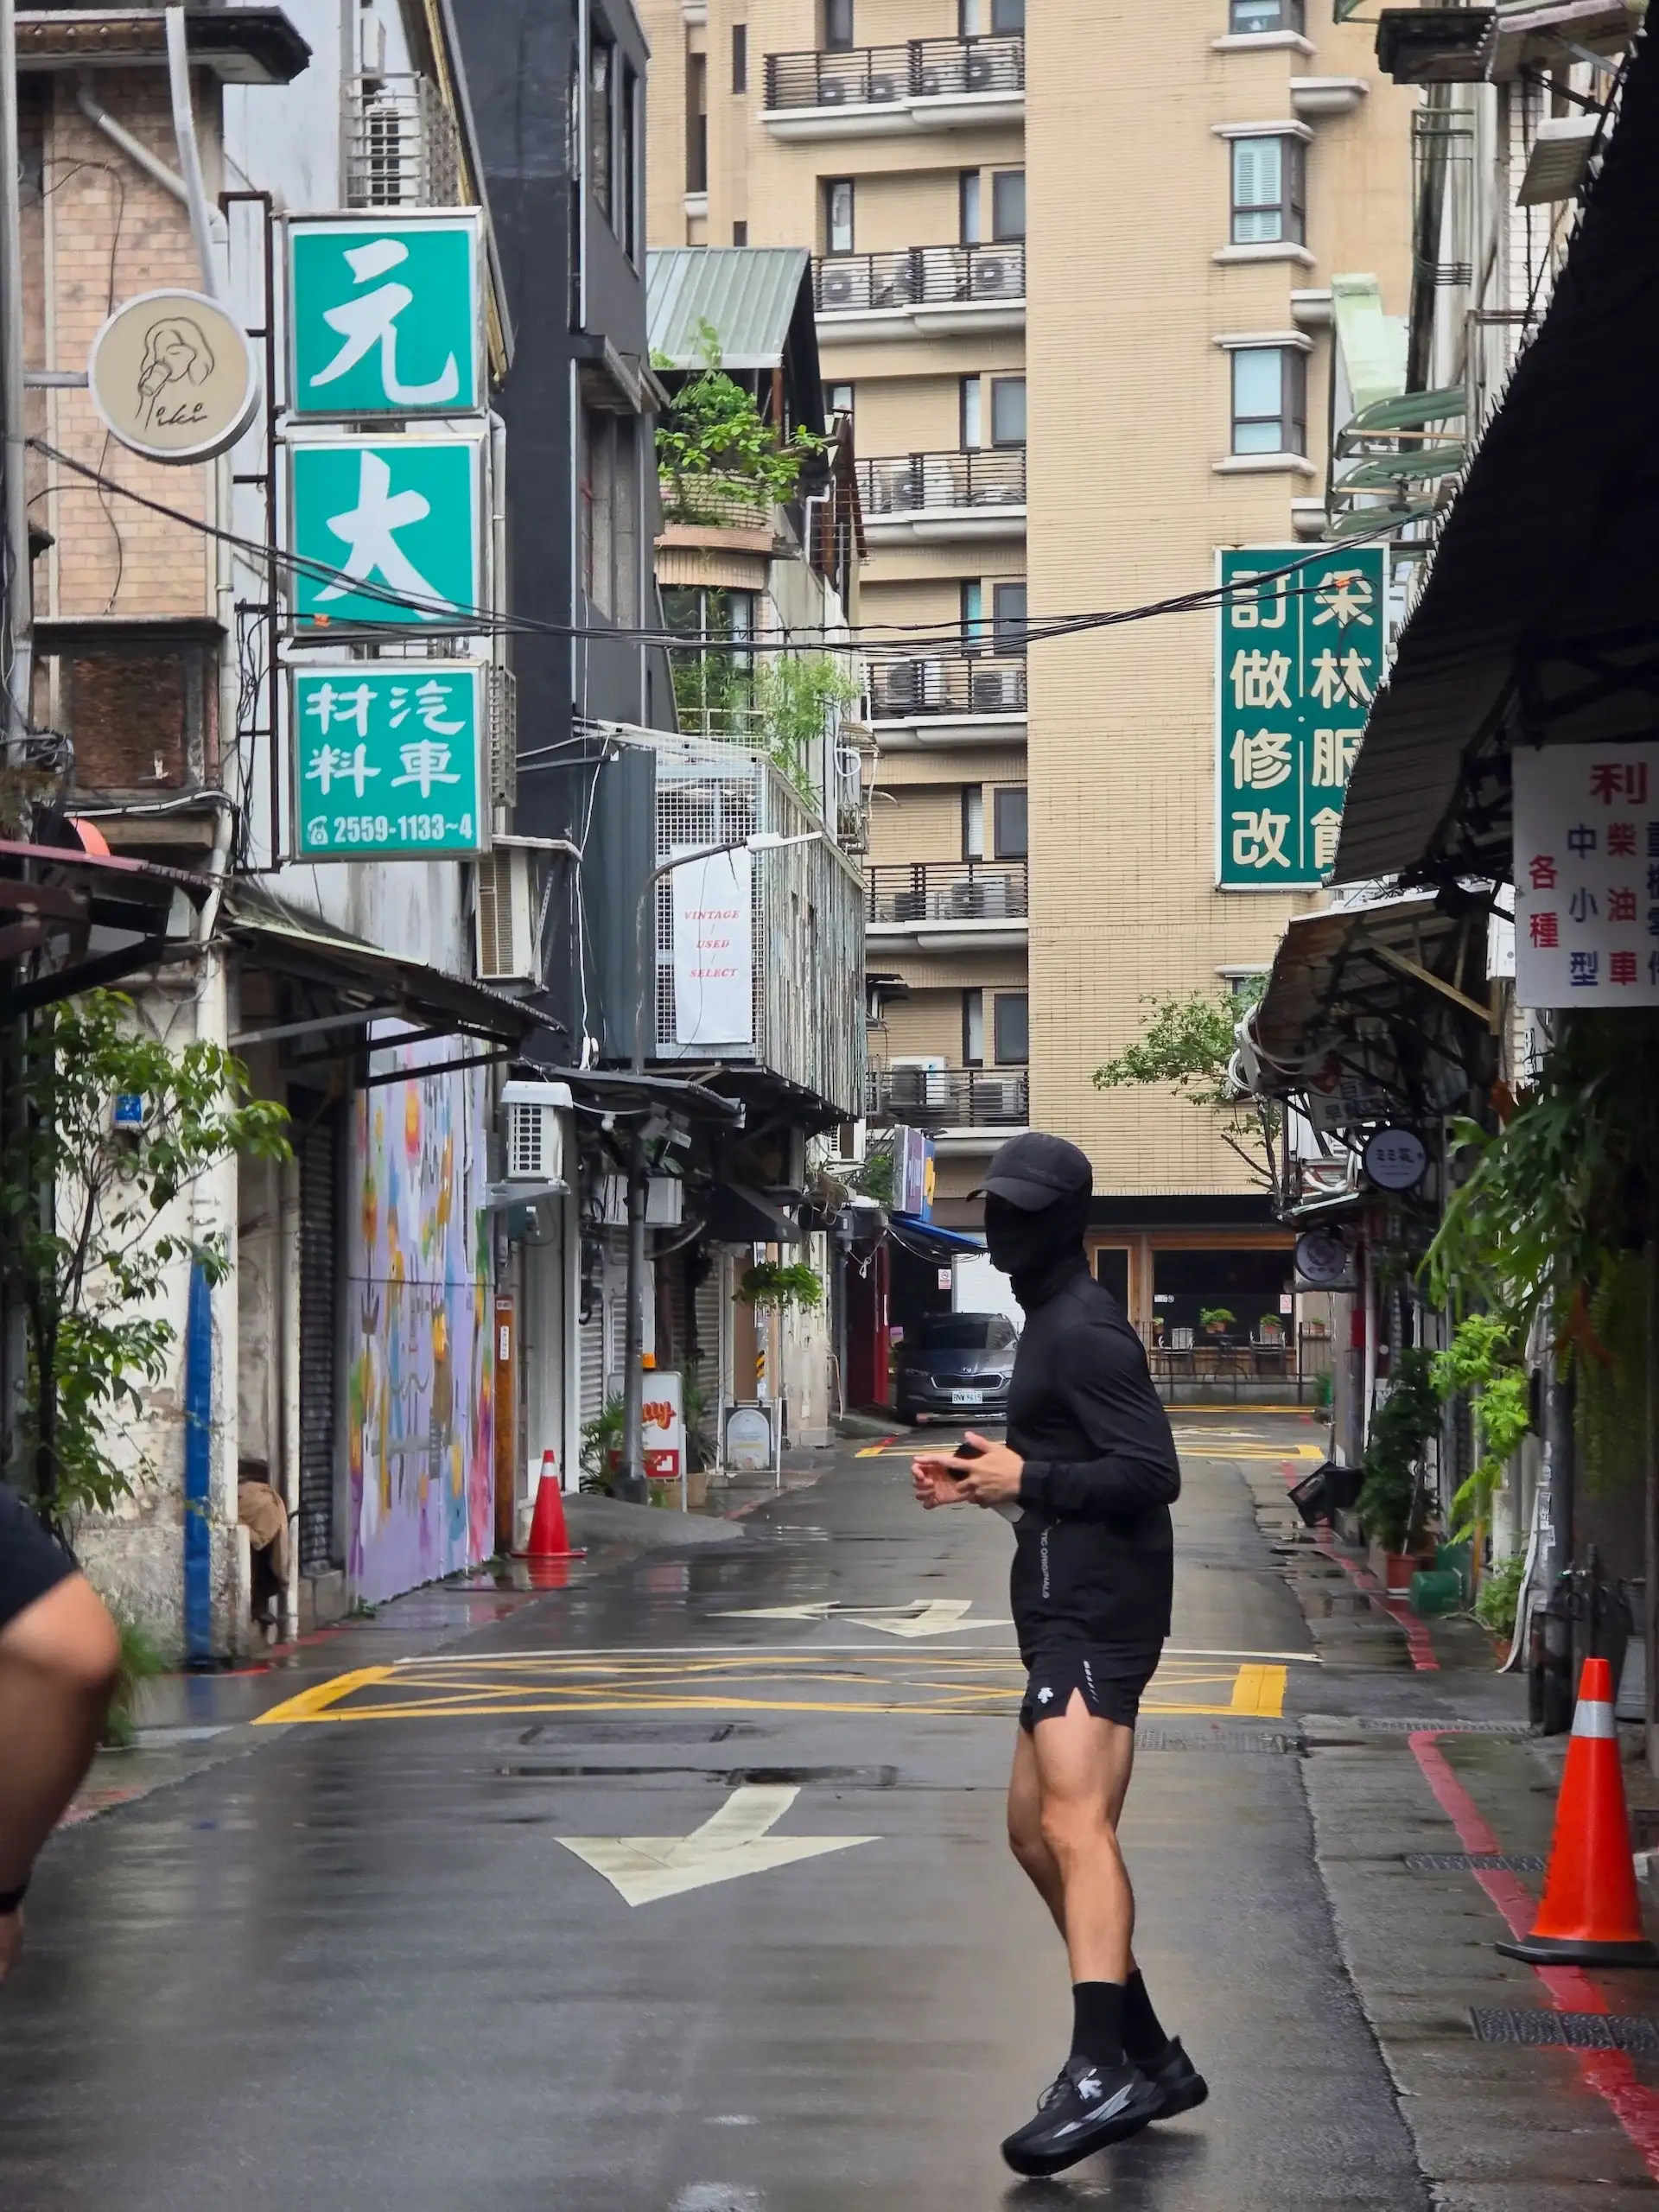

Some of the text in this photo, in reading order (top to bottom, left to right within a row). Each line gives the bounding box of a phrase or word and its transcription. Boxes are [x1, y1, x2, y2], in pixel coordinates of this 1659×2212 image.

[305, 681, 381, 799] 材料
[389, 678, 467, 798] 汽車
[1230, 570, 1293, 869] 訂做修改
[1589, 762, 1648, 805] 利
[684, 910, 740, 920] VINTAGE
[696, 939, 730, 949] USED
[1529, 854, 1560, 949] 各種
[1567, 823, 1599, 988] 中小型
[1606, 822, 1637, 986] 柴油車
[690, 969, 738, 978] SELECT
